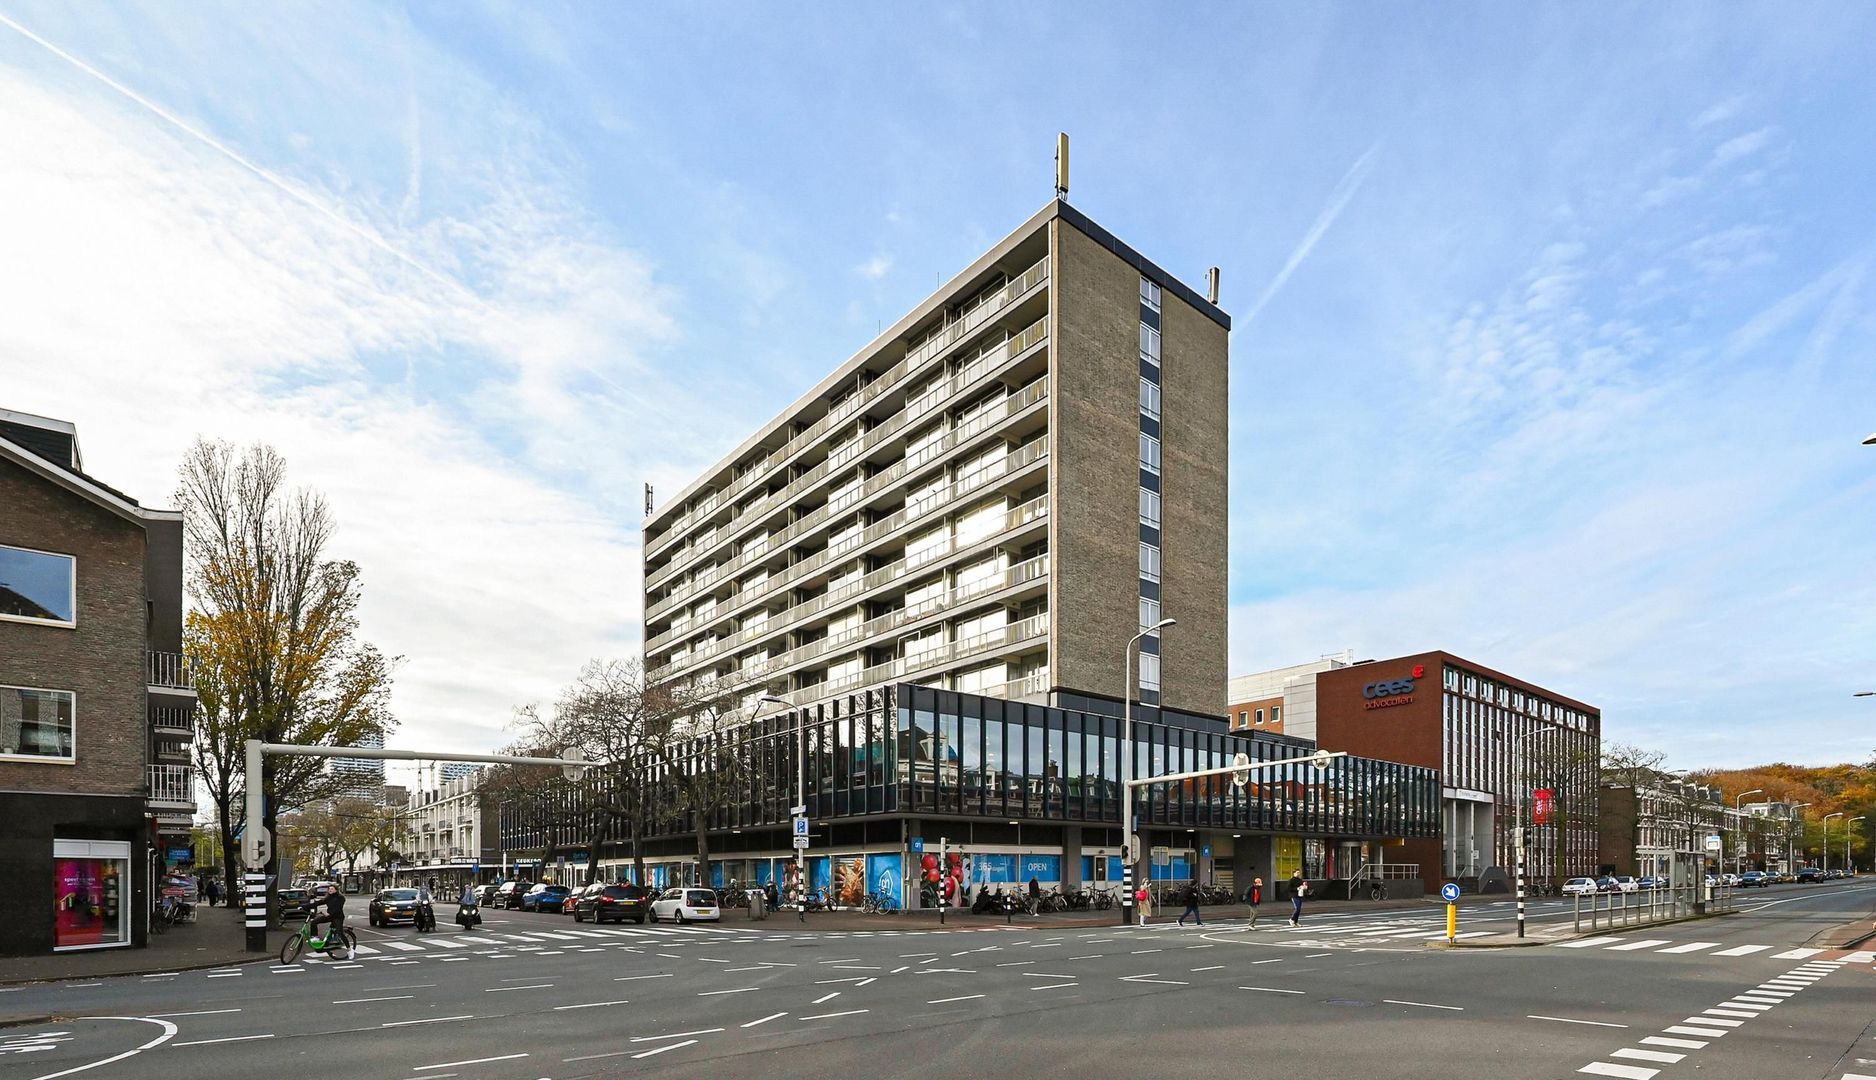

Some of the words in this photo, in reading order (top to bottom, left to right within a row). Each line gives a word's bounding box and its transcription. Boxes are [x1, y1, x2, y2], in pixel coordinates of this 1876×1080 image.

[1363, 678, 1414, 698] cees
[1363, 697, 1413, 710] advocaten
[978, 862, 992, 871] 365
[1028, 863, 1047, 872] OPEN
